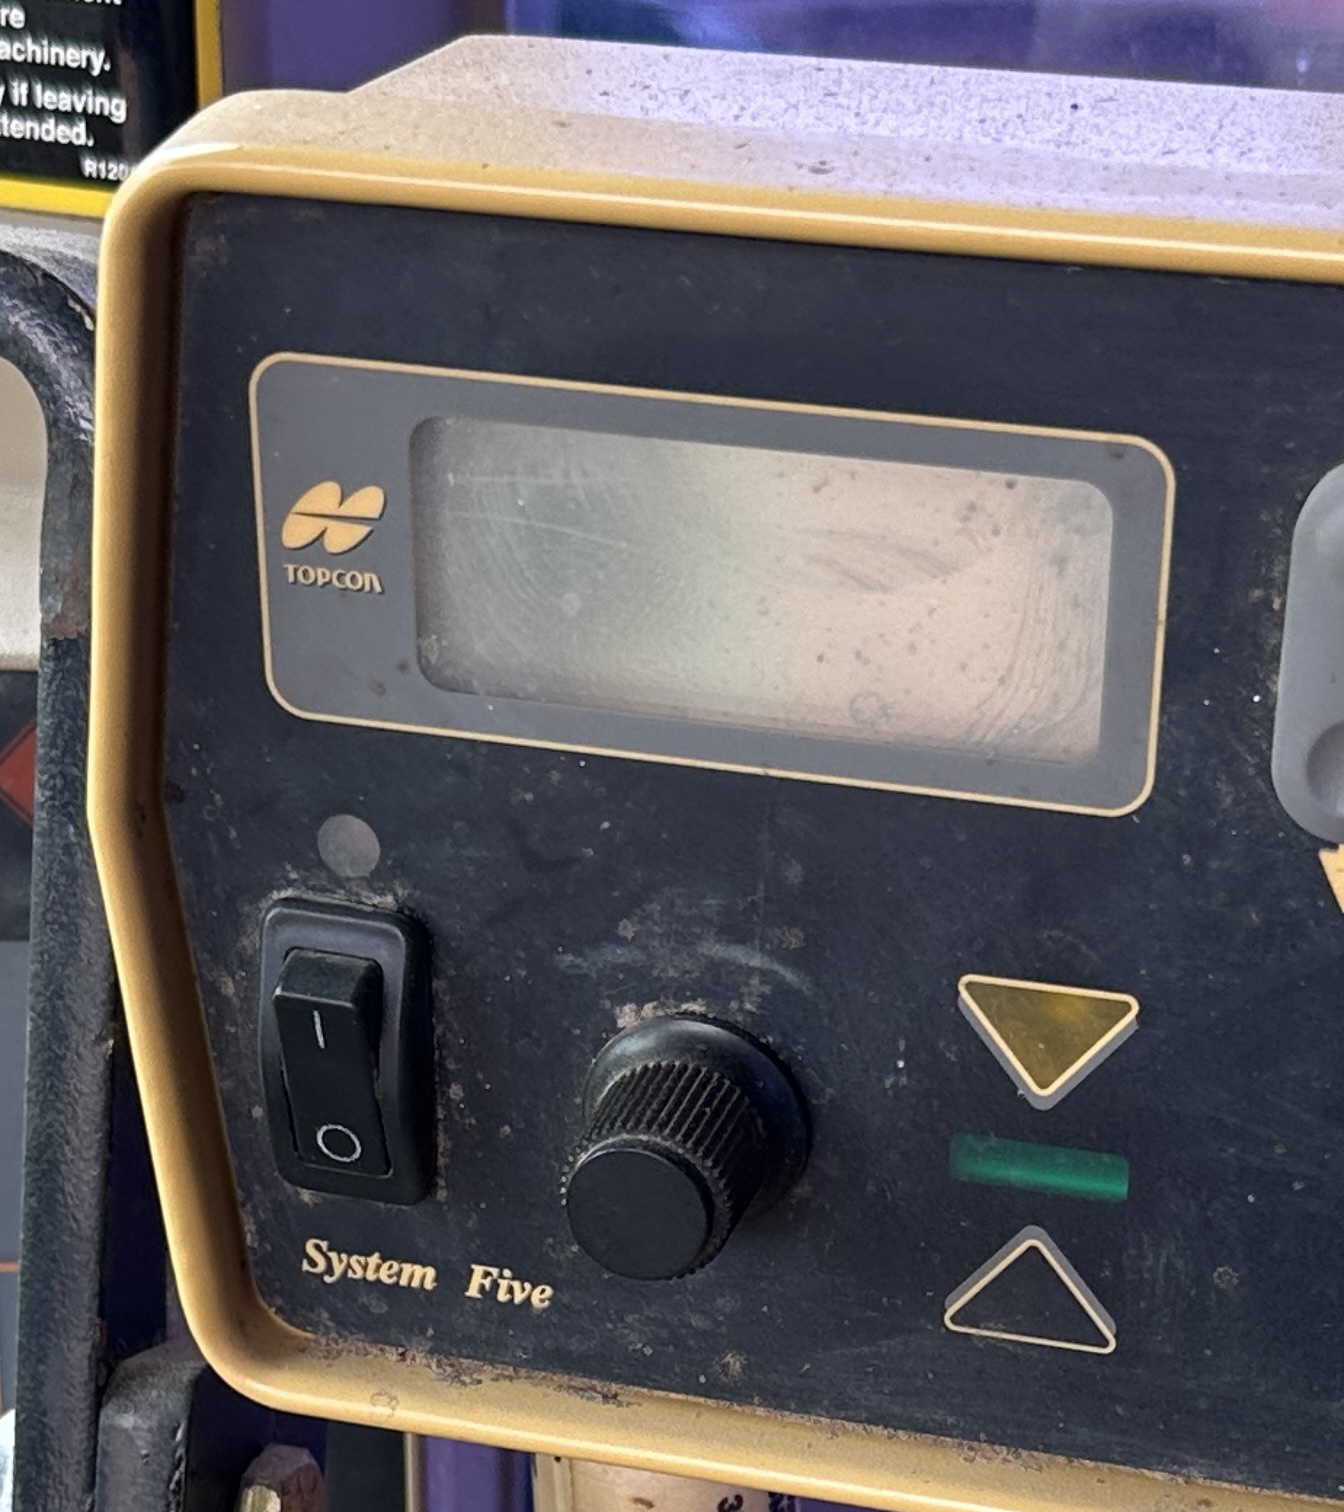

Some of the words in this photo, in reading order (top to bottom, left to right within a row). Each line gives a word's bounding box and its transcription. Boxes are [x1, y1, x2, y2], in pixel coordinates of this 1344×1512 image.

[10, 76, 30, 107] if
[33, 73, 127, 122] leaving
[83, 158, 134, 181] R120
[301, 1239, 438, 1292] System
[464, 1264, 554, 1310] Five
